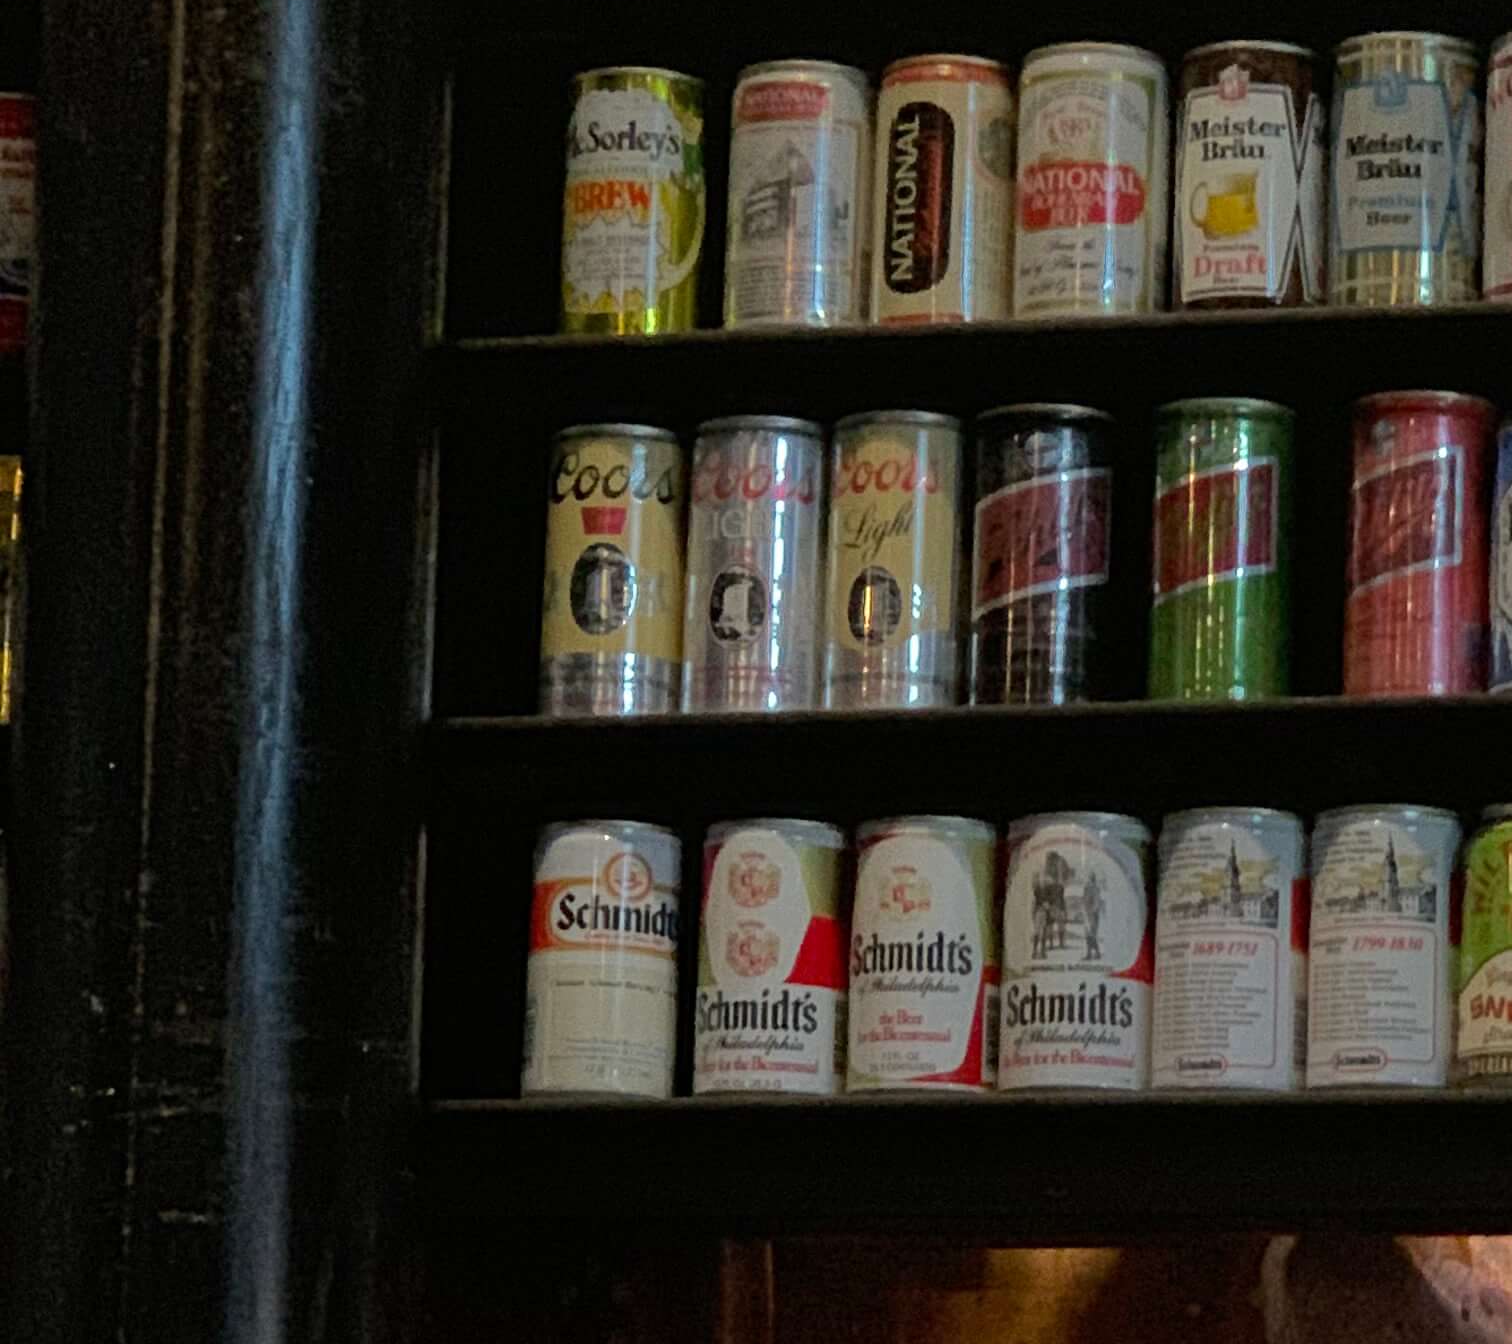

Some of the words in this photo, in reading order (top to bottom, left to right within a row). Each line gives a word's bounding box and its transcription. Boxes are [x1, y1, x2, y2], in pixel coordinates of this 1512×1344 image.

[1188, 114, 1287, 143] Meister
[1345, 129, 1444, 156] Meister
[573, 180, 652, 215] BREW
[890, 113, 921, 283] NATIONAL
[1021, 166, 1140, 195] NATIONAL
[1193, 252, 1267, 277] Draft
[551, 452, 675, 506] Coors
[834, 455, 940, 495] Coors
[845, 502, 924, 562] Light
[850, 930, 974, 978] Schmidt's
[698, 989, 819, 1034] Schmidt's
[1005, 982, 1134, 1029] Schmidt's
